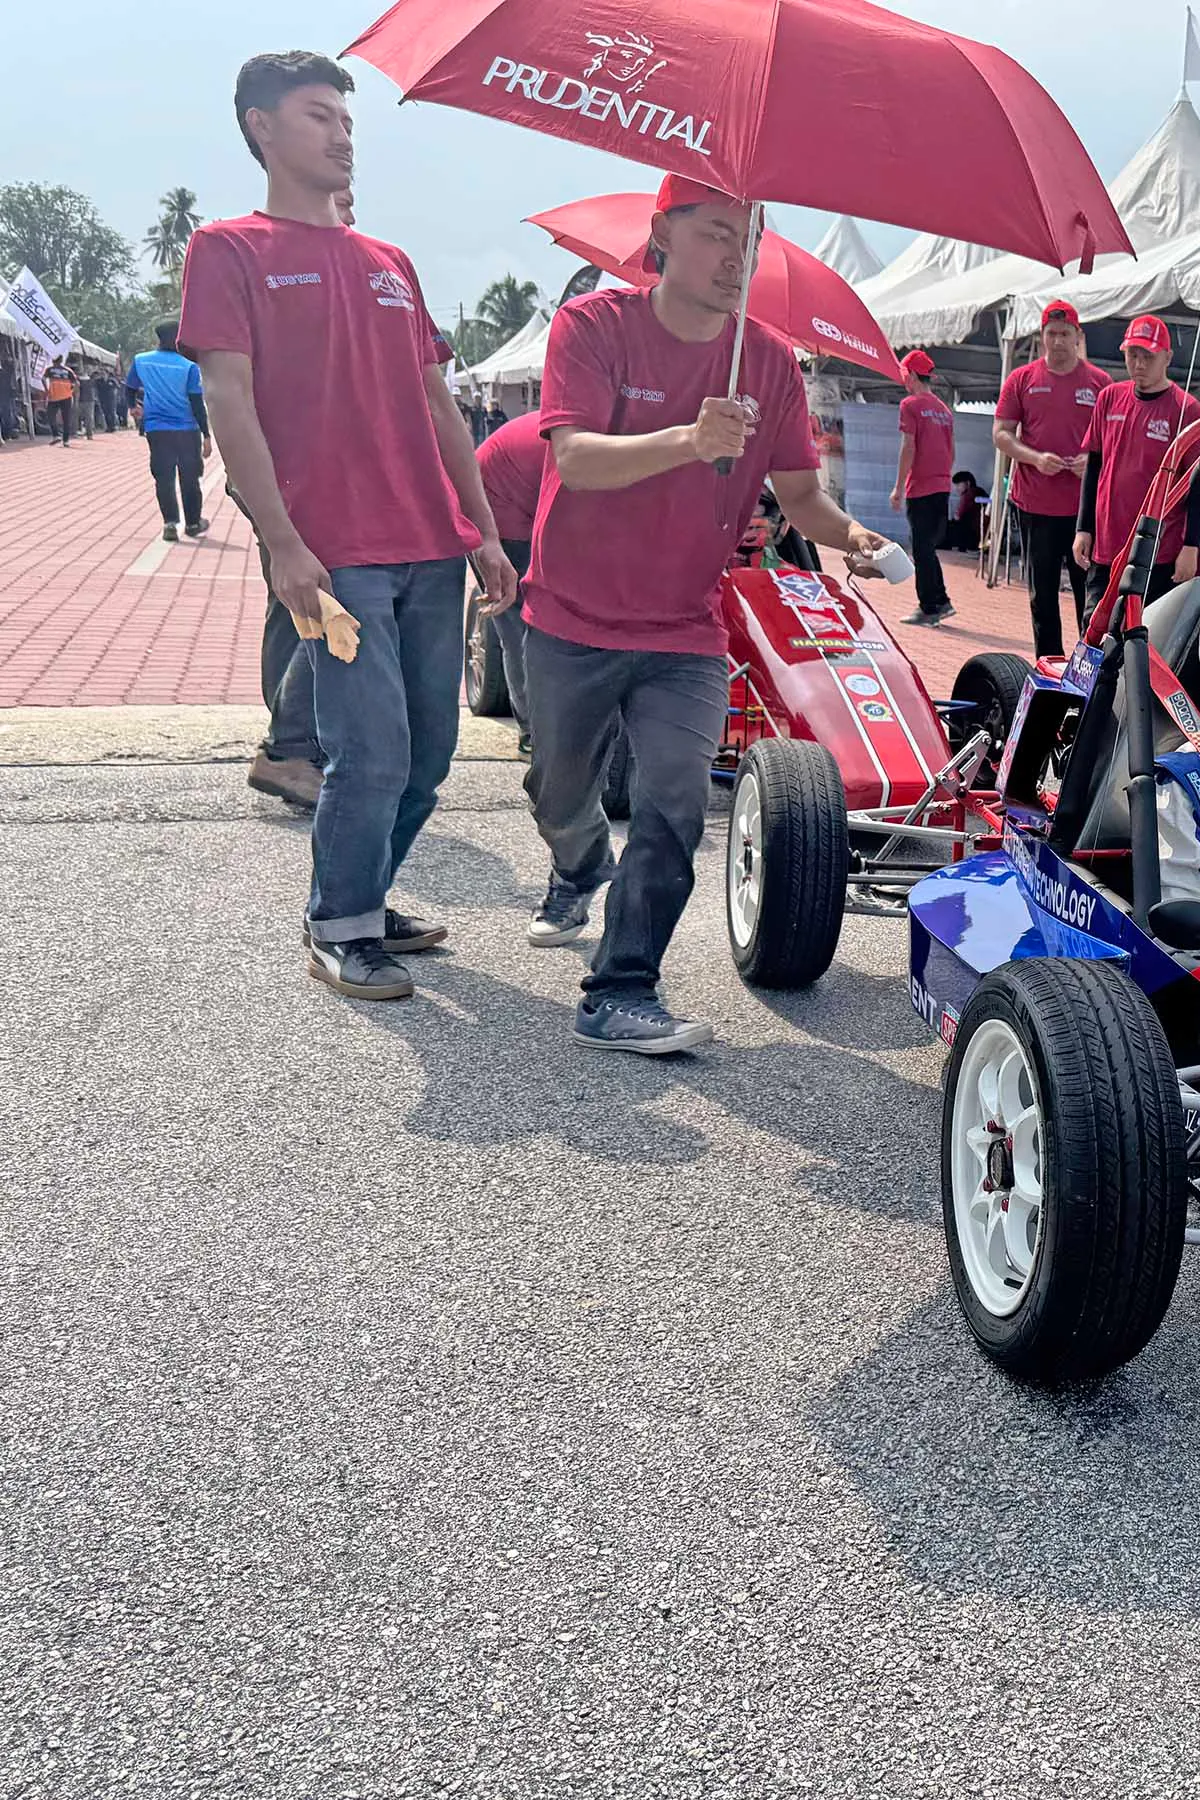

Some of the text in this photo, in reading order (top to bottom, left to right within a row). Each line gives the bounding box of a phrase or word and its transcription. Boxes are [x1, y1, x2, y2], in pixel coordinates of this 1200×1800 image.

[482, 56, 711, 155] PRUDENTIAL
[793, 639, 850, 648] HANDAL
[1173, 692, 1196, 733] sparco
